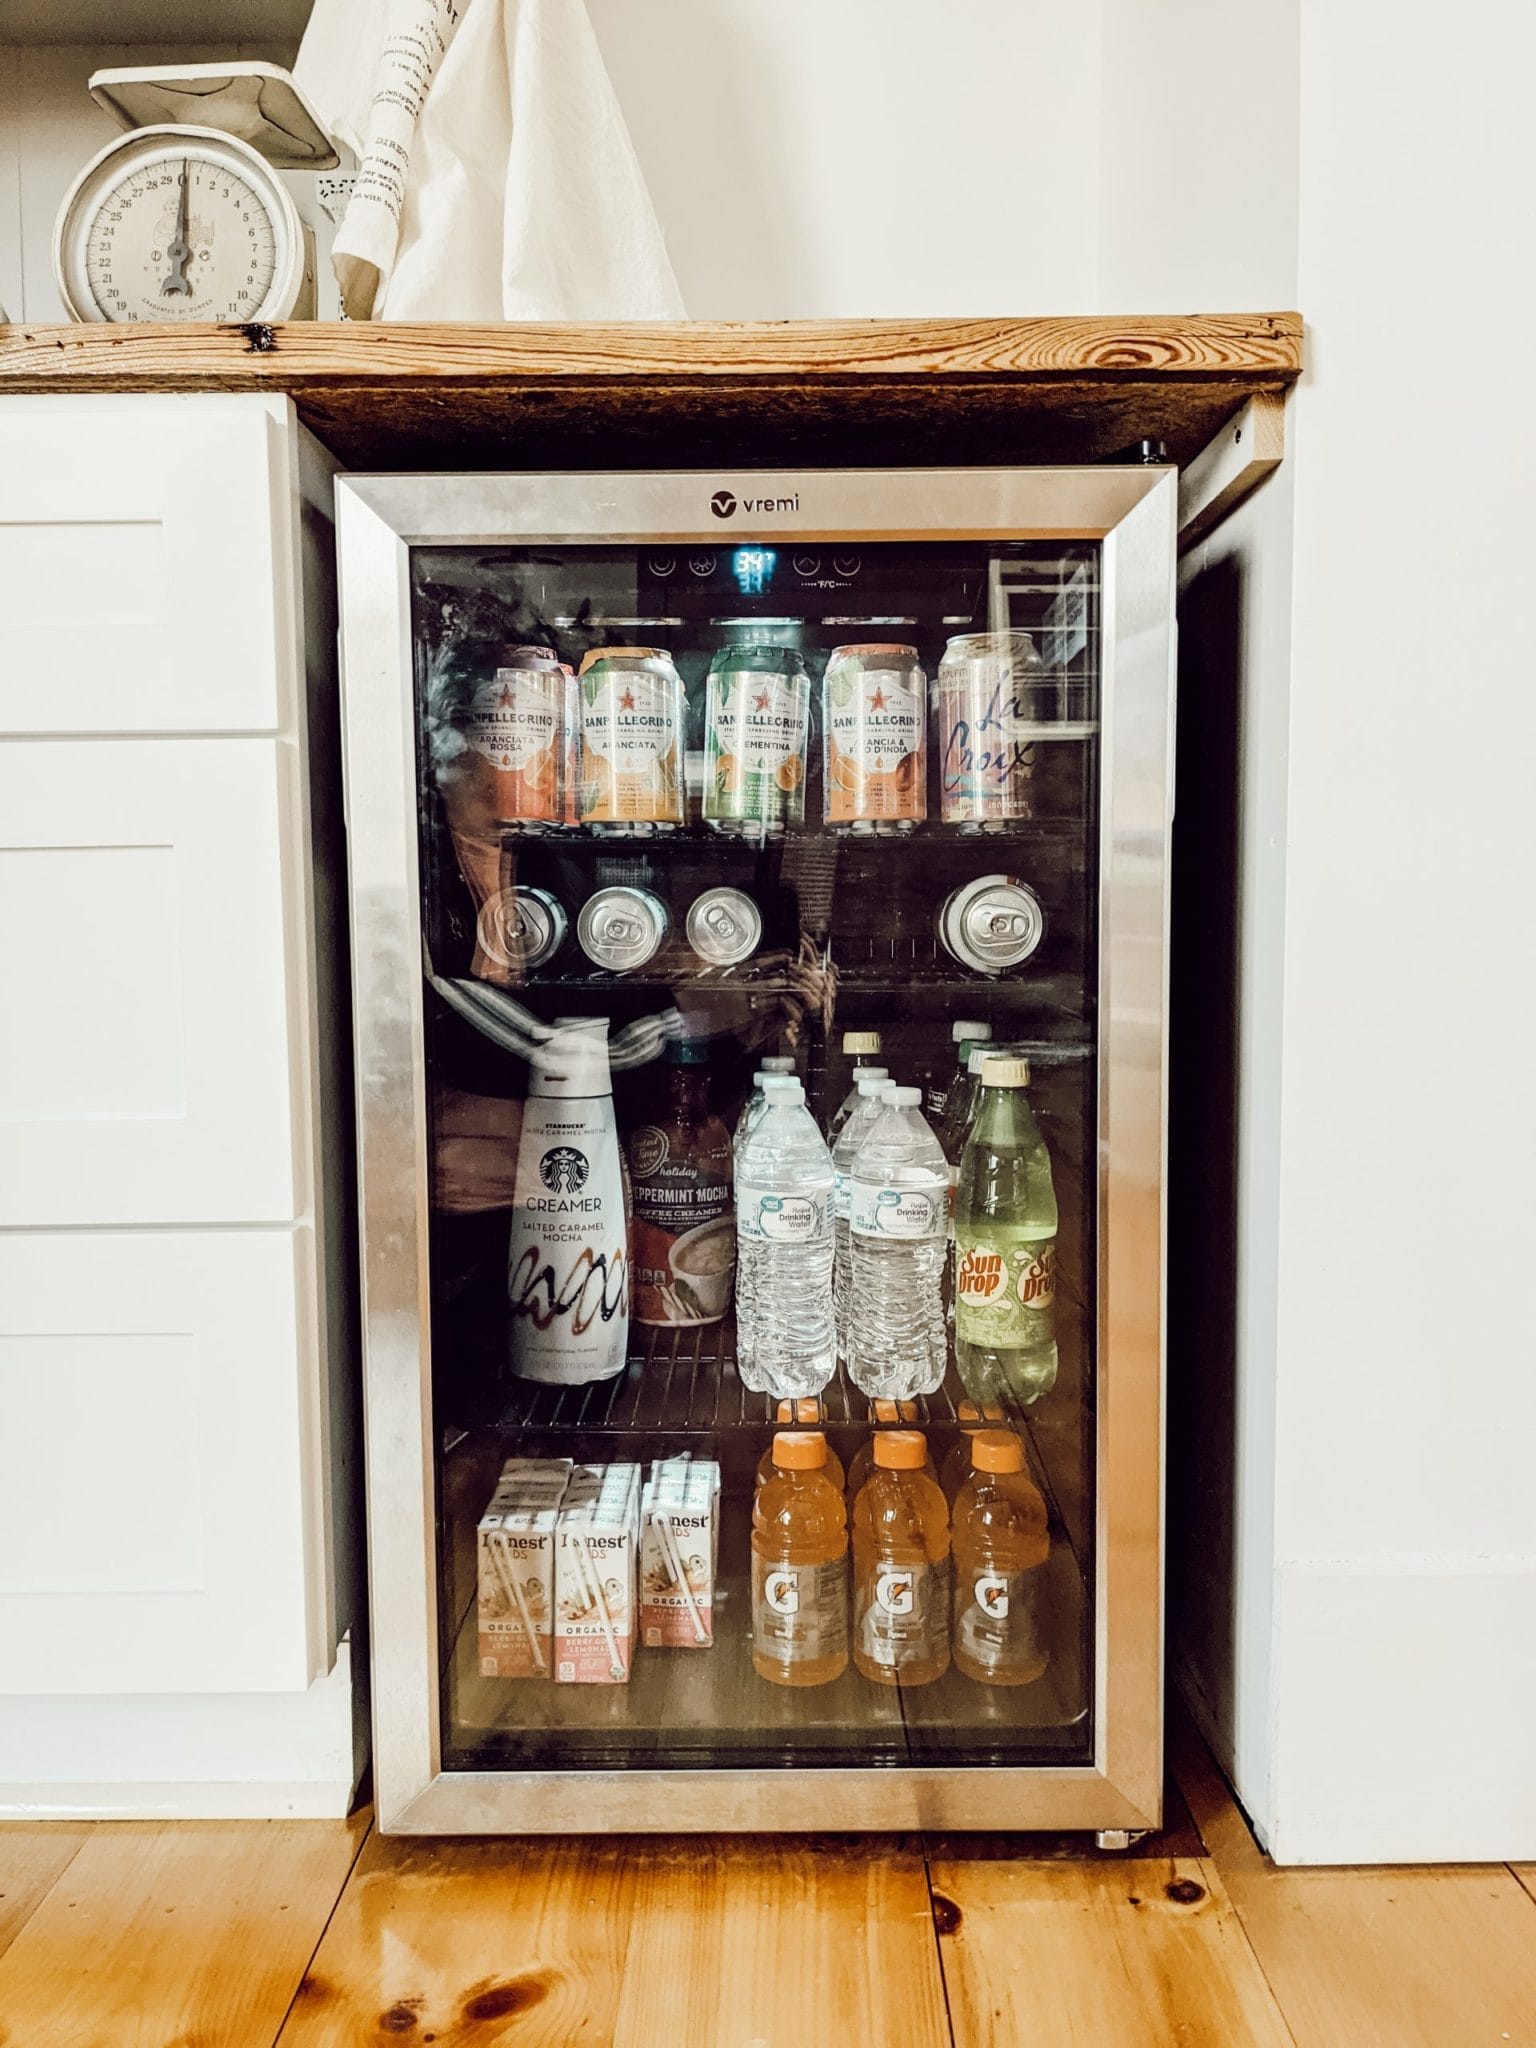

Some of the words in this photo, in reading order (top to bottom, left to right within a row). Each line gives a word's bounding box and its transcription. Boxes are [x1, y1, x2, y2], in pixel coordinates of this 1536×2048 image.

[146, 180, 158, 190] 28
[160, 176, 172, 185] 29
[196, 176, 200, 185] 1
[209, 181, 216, 190] 2
[132, 188, 144, 198] 27
[223, 189, 229, 198] 3
[120, 199, 132, 209] 26
[233, 200, 240, 209] 4
[110, 212, 122, 221] 25
[243, 212, 249, 222] 5
[103, 227, 115, 236] 24
[249, 228, 255, 237] 6
[100, 241, 112, 251] 23
[252, 243, 258, 253] 7
[99, 258, 111, 267] 22
[251, 259, 257, 269] 8
[102, 274, 113, 283] 21
[247, 275, 253, 285] 9
[107, 289, 119, 298] 20
[237, 290, 248, 300] 10
[116, 302, 127, 311] 19
[228, 303, 238, 312] 11
[128, 312, 138, 321] 18
[216, 313, 225, 322] 12
[743, 493, 800, 512] vremi
[480, 736, 535, 744] ARANCIATA
[490, 744, 522, 752] ROSSA
[943, 720, 1036, 792] Croix
[660, 1166, 698, 1179] holiday
[697, 1185, 729, 1202] MOCHA
[526, 1197, 602, 1213] CREAMER
[674, 1207, 722, 1217] CREAMER
[896, 1208, 928, 1217] Drinking
[779, 1213, 811, 1222] Drinking
[522, 1221, 556, 1232] SALTED
[558, 1222, 605, 1233] CARAMEL
[543, 1233, 583, 1243] MOCHA
[961, 1248, 1002, 1274] Sun
[959, 1272, 1000, 1298] Drop
[764, 1571, 799, 1615] G
[876, 1571, 914, 1615] G
[974, 1576, 1009, 1620] G
[566, 1627, 619, 1635] ORGANC
